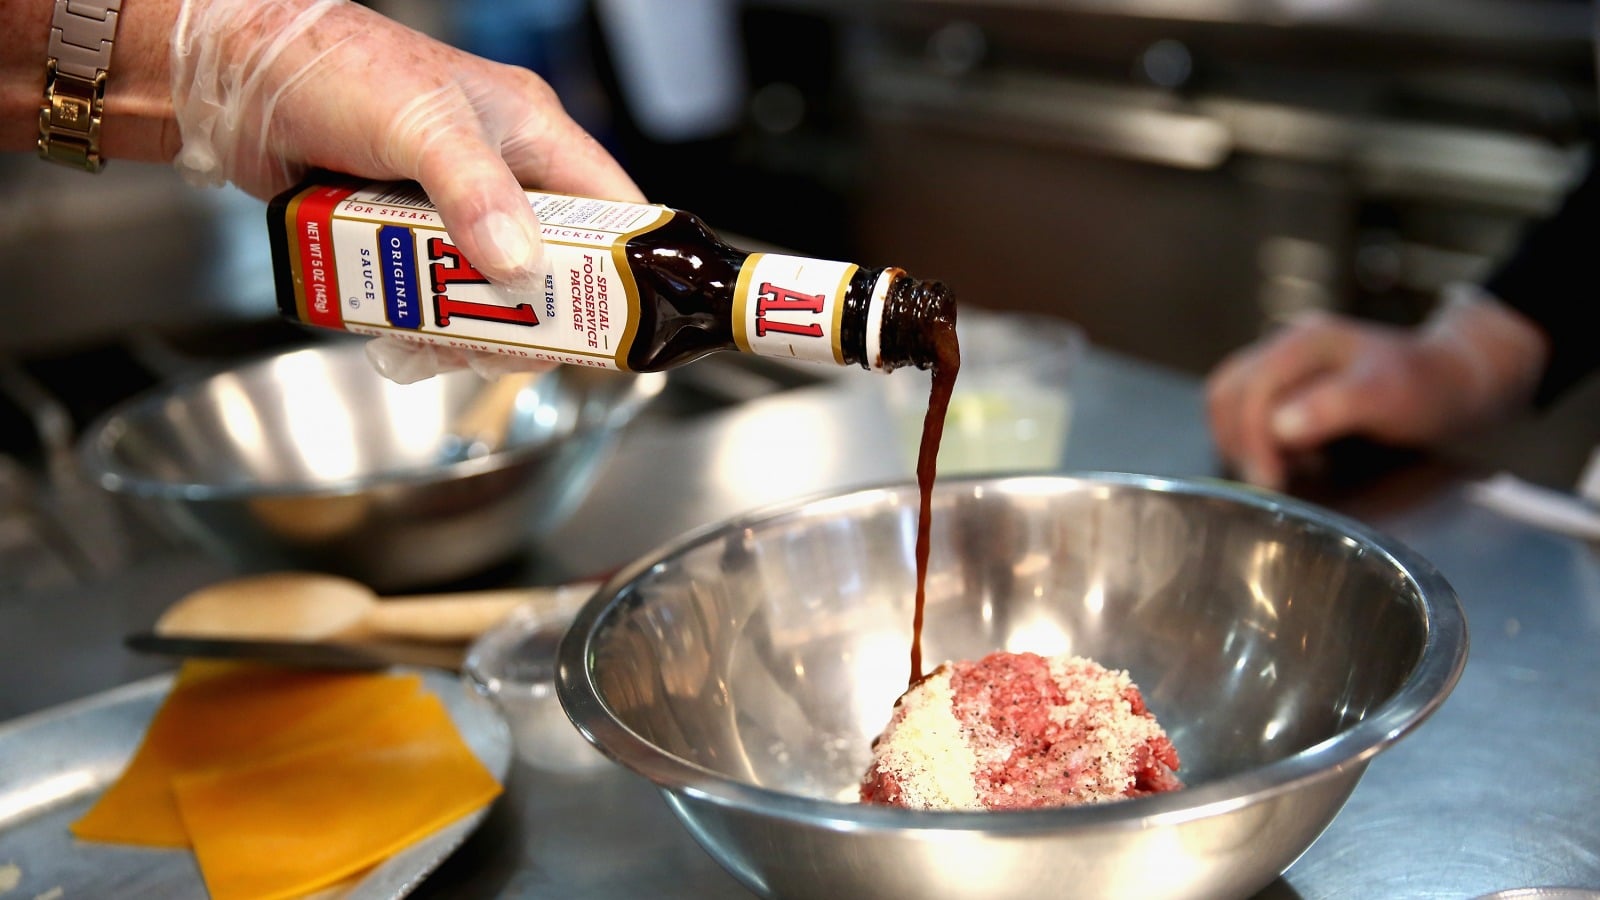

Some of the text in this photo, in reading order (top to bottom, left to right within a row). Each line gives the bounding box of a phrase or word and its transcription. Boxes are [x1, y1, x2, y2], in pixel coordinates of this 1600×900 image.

[344, 202, 373, 214] FOR
[307, 221, 320, 242] NET
[541, 227, 605, 241] HICKEN
[309, 243, 323, 259] WT
[312, 260, 323, 268] 5
[360, 248, 375, 300] SAUCE
[313, 268, 326, 283] OZ
[390, 237, 409, 320] ORIGINAL
[545, 274, 556, 318] EST 1862
[570, 268, 584, 332] PACKAGE
[583, 253, 598, 348] FOODSERVICE
[597, 275, 610, 331] SPECIAL
[497, 347, 528, 357] AND
[535, 353, 607, 368] CHICKEN
